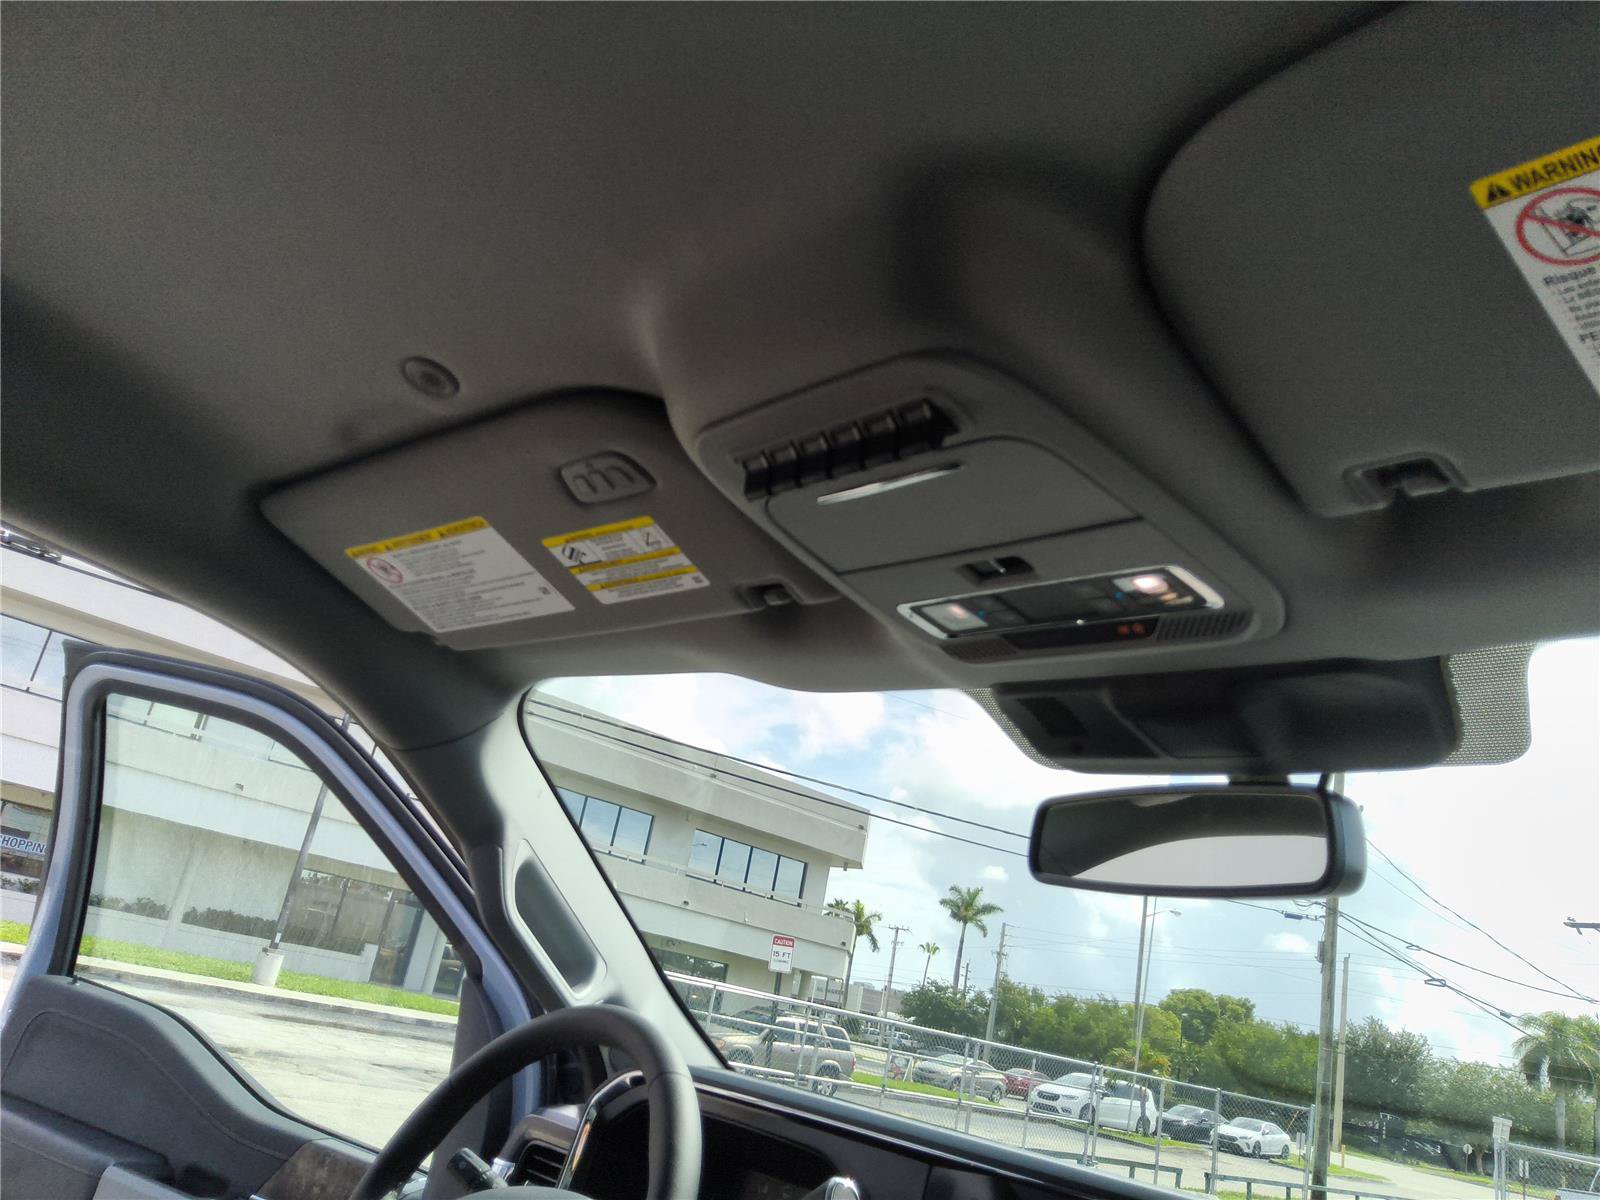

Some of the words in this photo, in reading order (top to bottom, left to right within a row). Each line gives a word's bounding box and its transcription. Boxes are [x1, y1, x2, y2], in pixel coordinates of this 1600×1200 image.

[1511, 145, 1600, 190] WARNIN
[774, 938, 794, 947] CAUTION
[781, 951, 791, 959] FT
